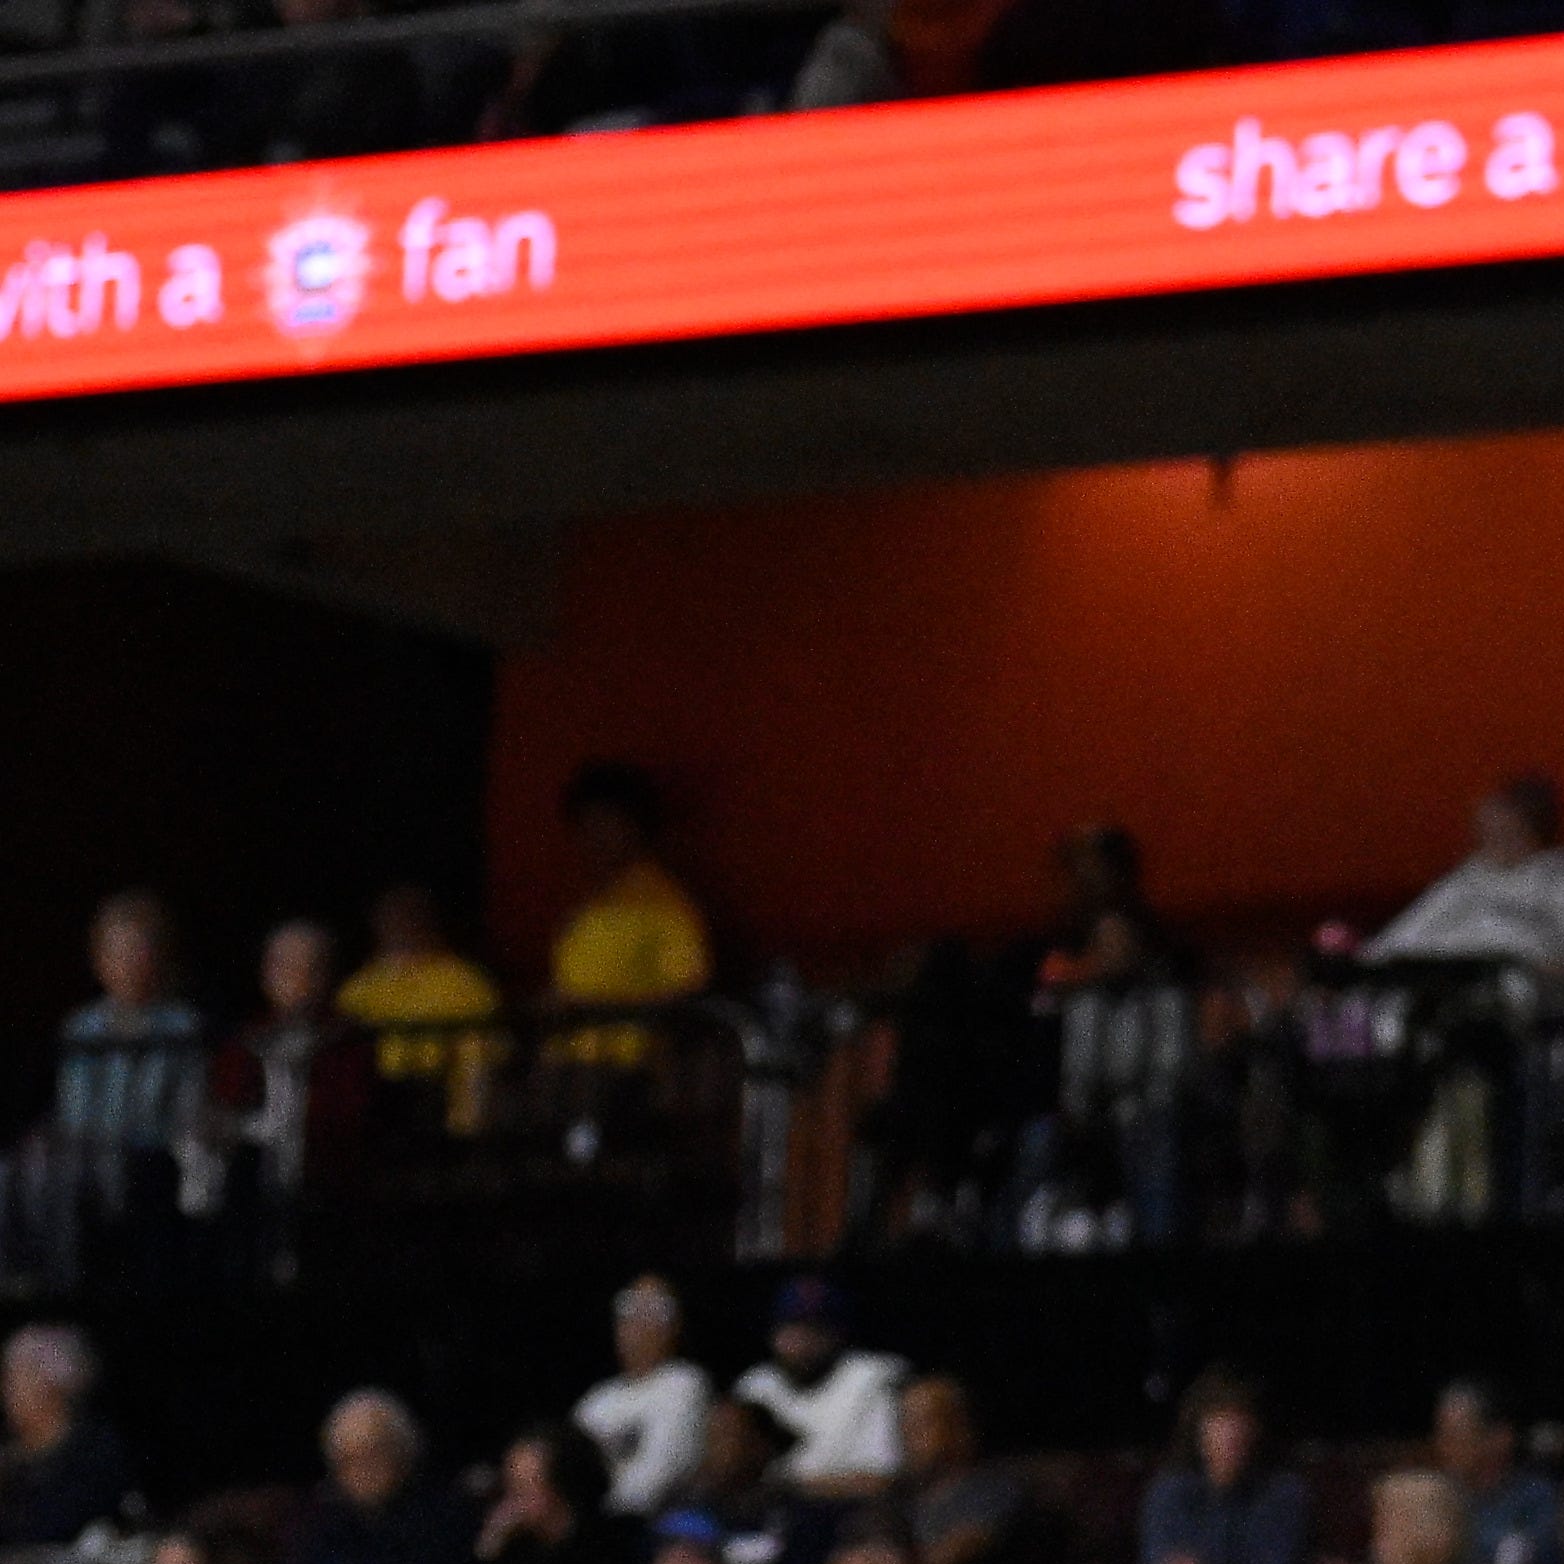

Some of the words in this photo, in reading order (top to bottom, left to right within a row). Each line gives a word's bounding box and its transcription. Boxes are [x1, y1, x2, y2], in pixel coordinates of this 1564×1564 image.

[1173, 115, 1468, 230] share
[1484, 111, 1559, 200] a
[158, 243, 222, 331] a
[399, 196, 556, 303] fan
